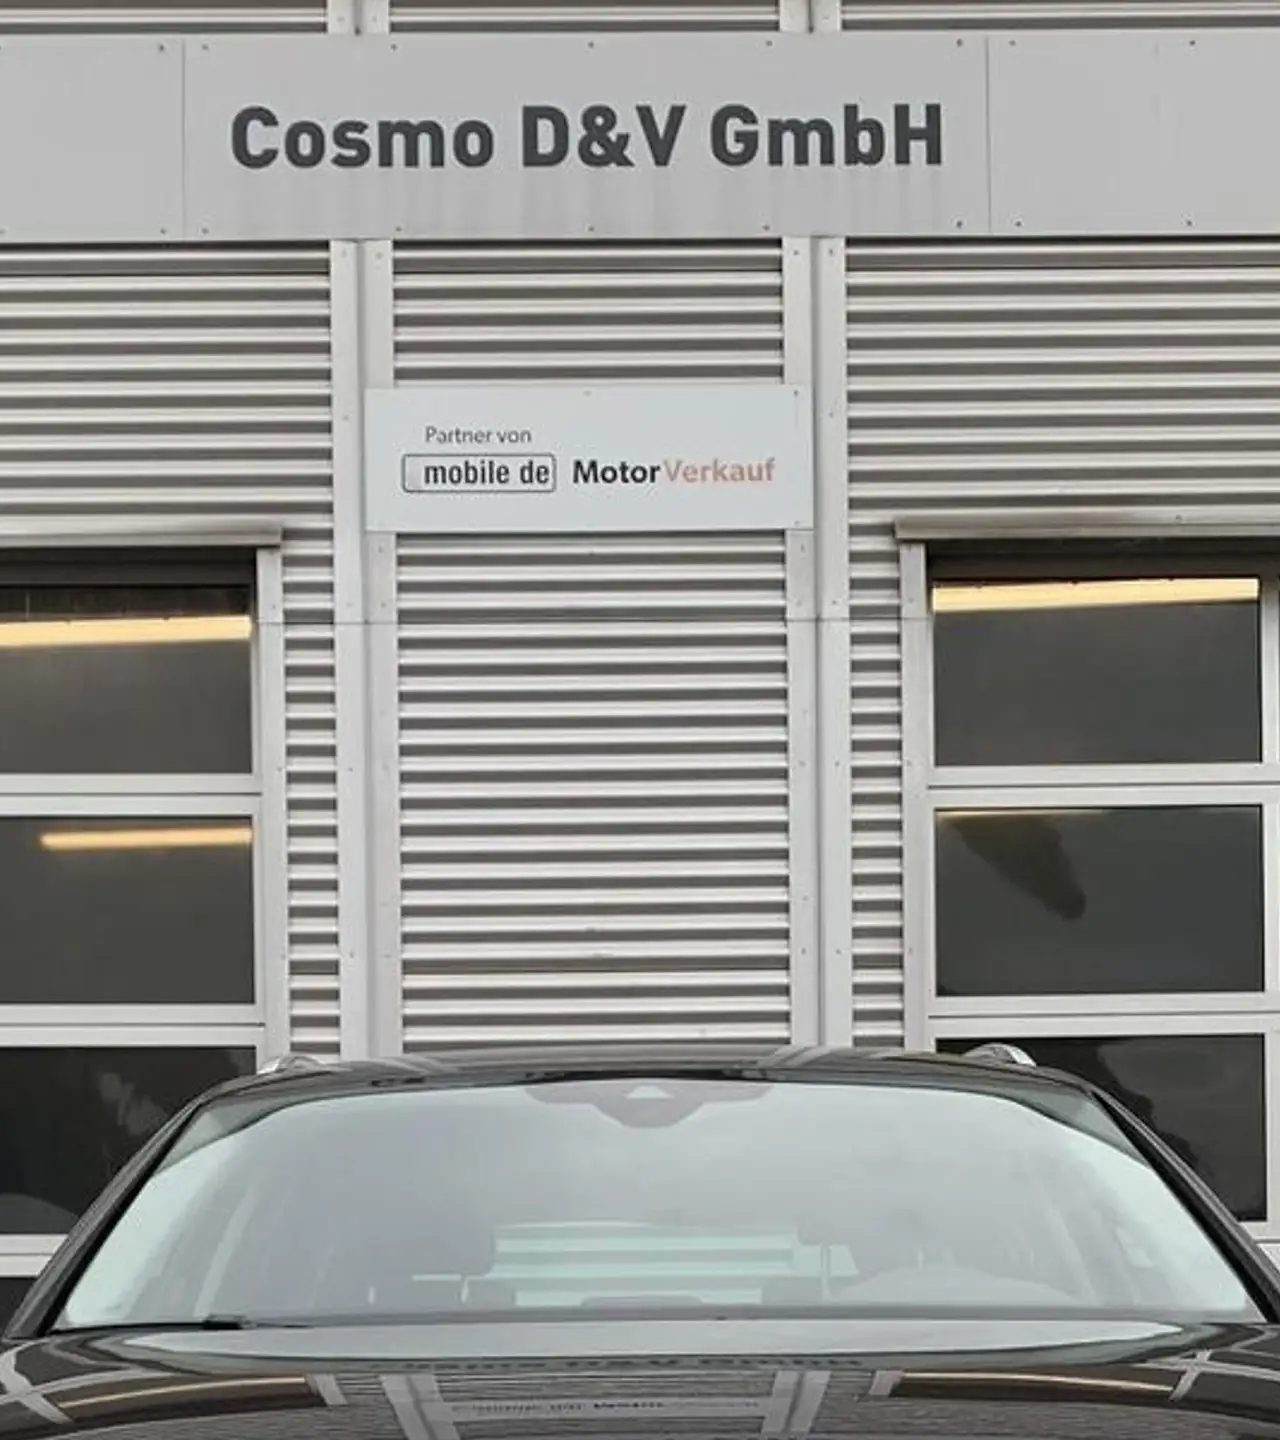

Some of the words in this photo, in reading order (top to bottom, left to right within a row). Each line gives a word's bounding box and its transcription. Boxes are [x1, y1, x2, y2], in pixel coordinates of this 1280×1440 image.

[231, 105, 495, 169] Cosmo
[521, 104, 687, 168] D&V
[709, 103, 943, 168] GmbH
[425, 426, 493, 444] Partner
[497, 430, 533, 444] von
